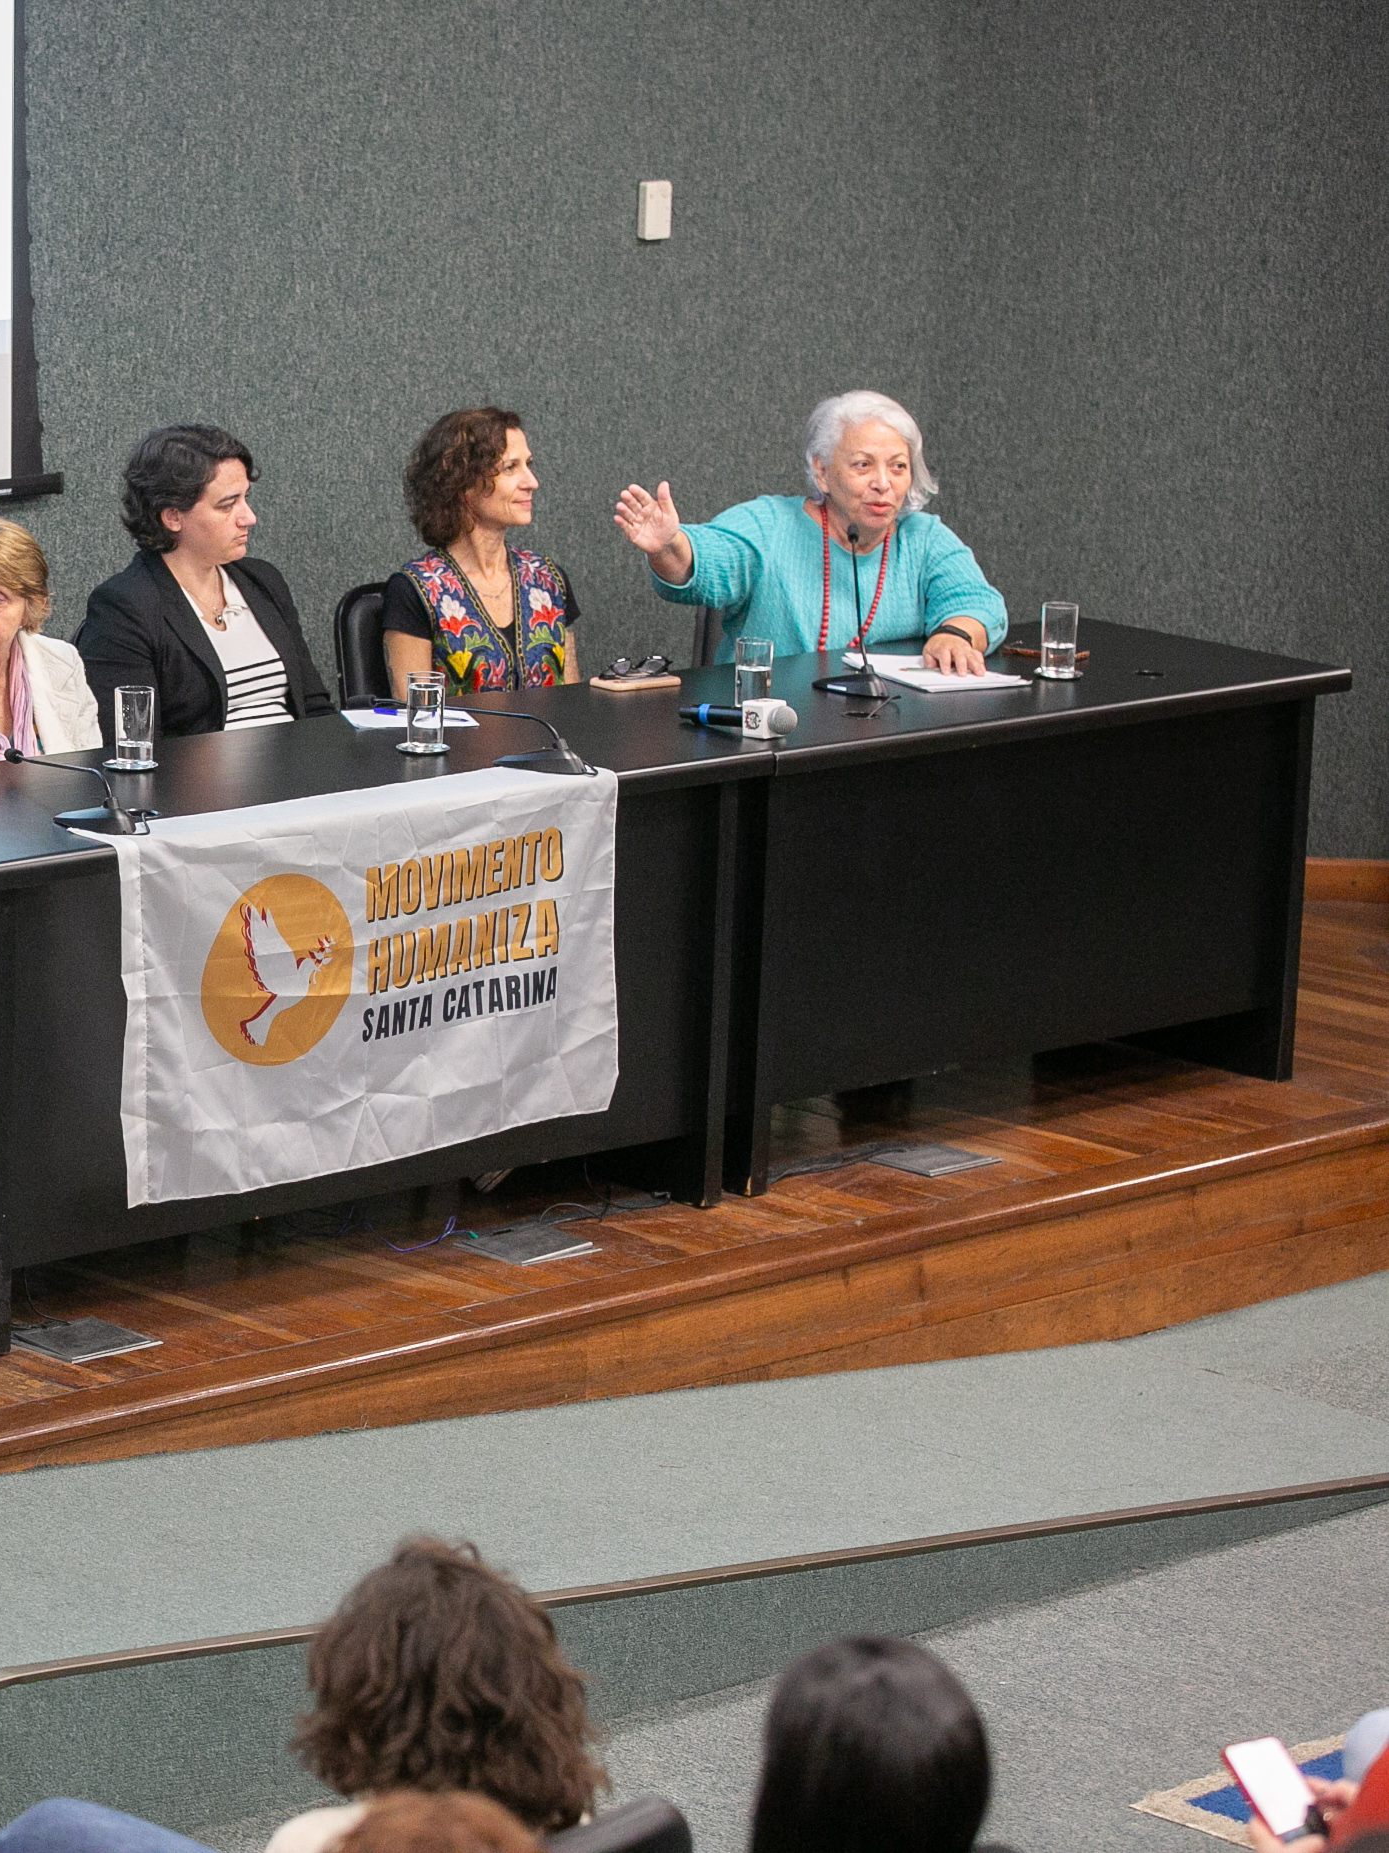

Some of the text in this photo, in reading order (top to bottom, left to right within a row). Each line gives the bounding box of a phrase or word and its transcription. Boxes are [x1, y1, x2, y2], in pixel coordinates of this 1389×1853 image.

[365, 826, 565, 923] MOVIMENTO
[366, 898, 560, 996] HUMANIZA
[362, 966, 558, 1043] SANTA CATARINA
